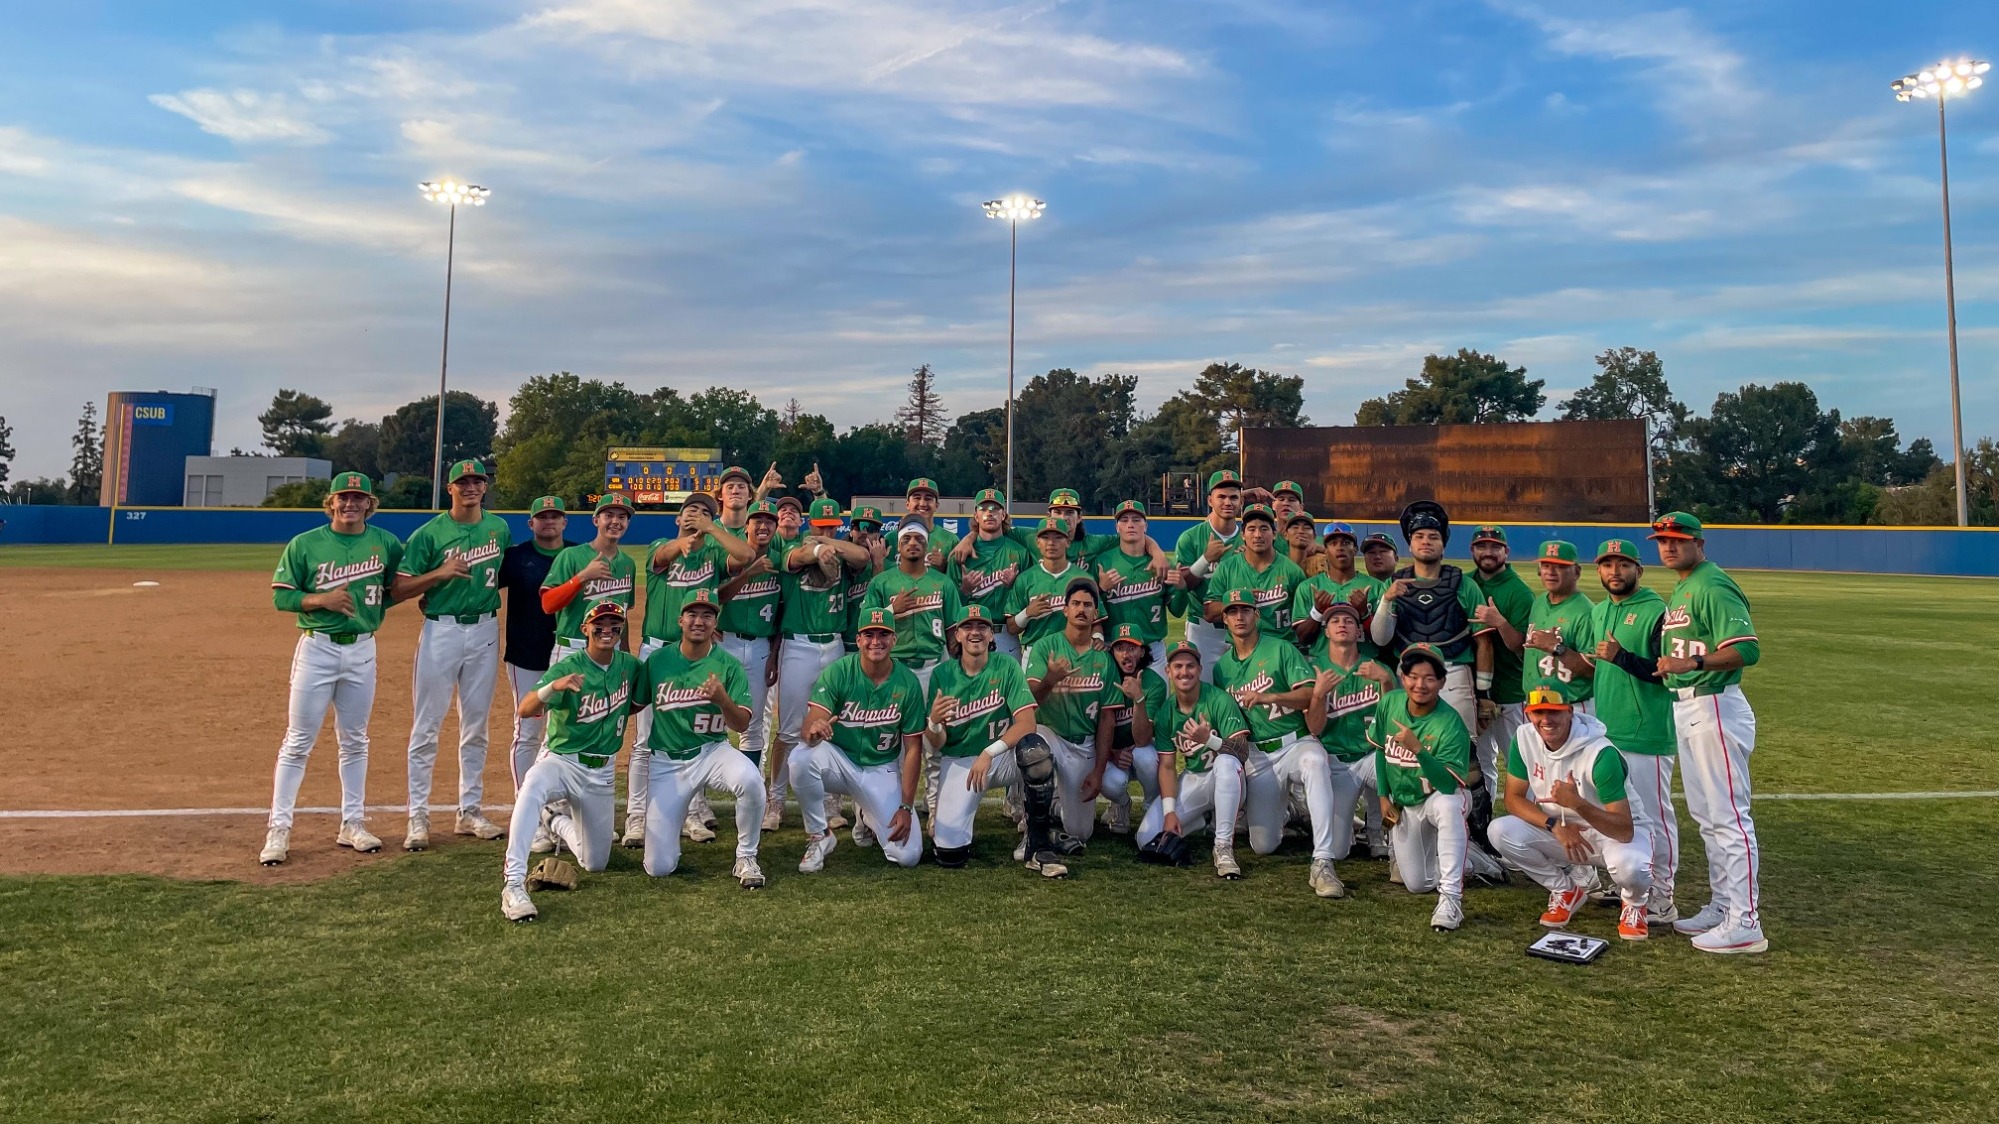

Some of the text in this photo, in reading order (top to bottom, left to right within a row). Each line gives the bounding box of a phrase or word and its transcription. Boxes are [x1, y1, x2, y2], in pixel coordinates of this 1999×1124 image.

[135, 407, 166, 419] CSUB
[463, 462, 475, 473] H
[348, 476, 361, 487] H
[985, 489, 995, 499] H
[543, 496, 555, 507] H
[759, 502, 770, 511] H
[1123, 500, 1134, 509] H
[126, 512, 147, 520] 327
[822, 505, 834, 516] H
[863, 508, 874, 518] H
[1546, 544, 1559, 556] H
[1607, 541, 1620, 552] H
[316, 555, 384, 590] Hawaii
[485, 568, 495, 586] 2
[667, 560, 714, 587] Hawaii
[584, 574, 632, 600] Hawaii
[737, 577, 781, 600] awaii
[696, 588, 708, 601] H
[1229, 590, 1241, 602] H
[760, 603, 773, 621] 4
[870, 611, 883, 623] H
[968, 606, 981, 617] H
[1150, 605, 1161, 623] 2
[1275, 609, 1291, 629] 13
[1623, 612, 1637, 626] H
[932, 619, 942, 637] 8
[1119, 625, 1131, 636] H
[1538, 655, 1573, 683] 45
[1053, 673, 1104, 693] awaii
[577, 679, 630, 723] Hawaii
[838, 701, 902, 728] Hawaii
[1085, 701, 1098, 719] 4
[616, 714, 625, 737] 9
[693, 713, 725, 734] 50
[1533, 763, 1545, 780] H
